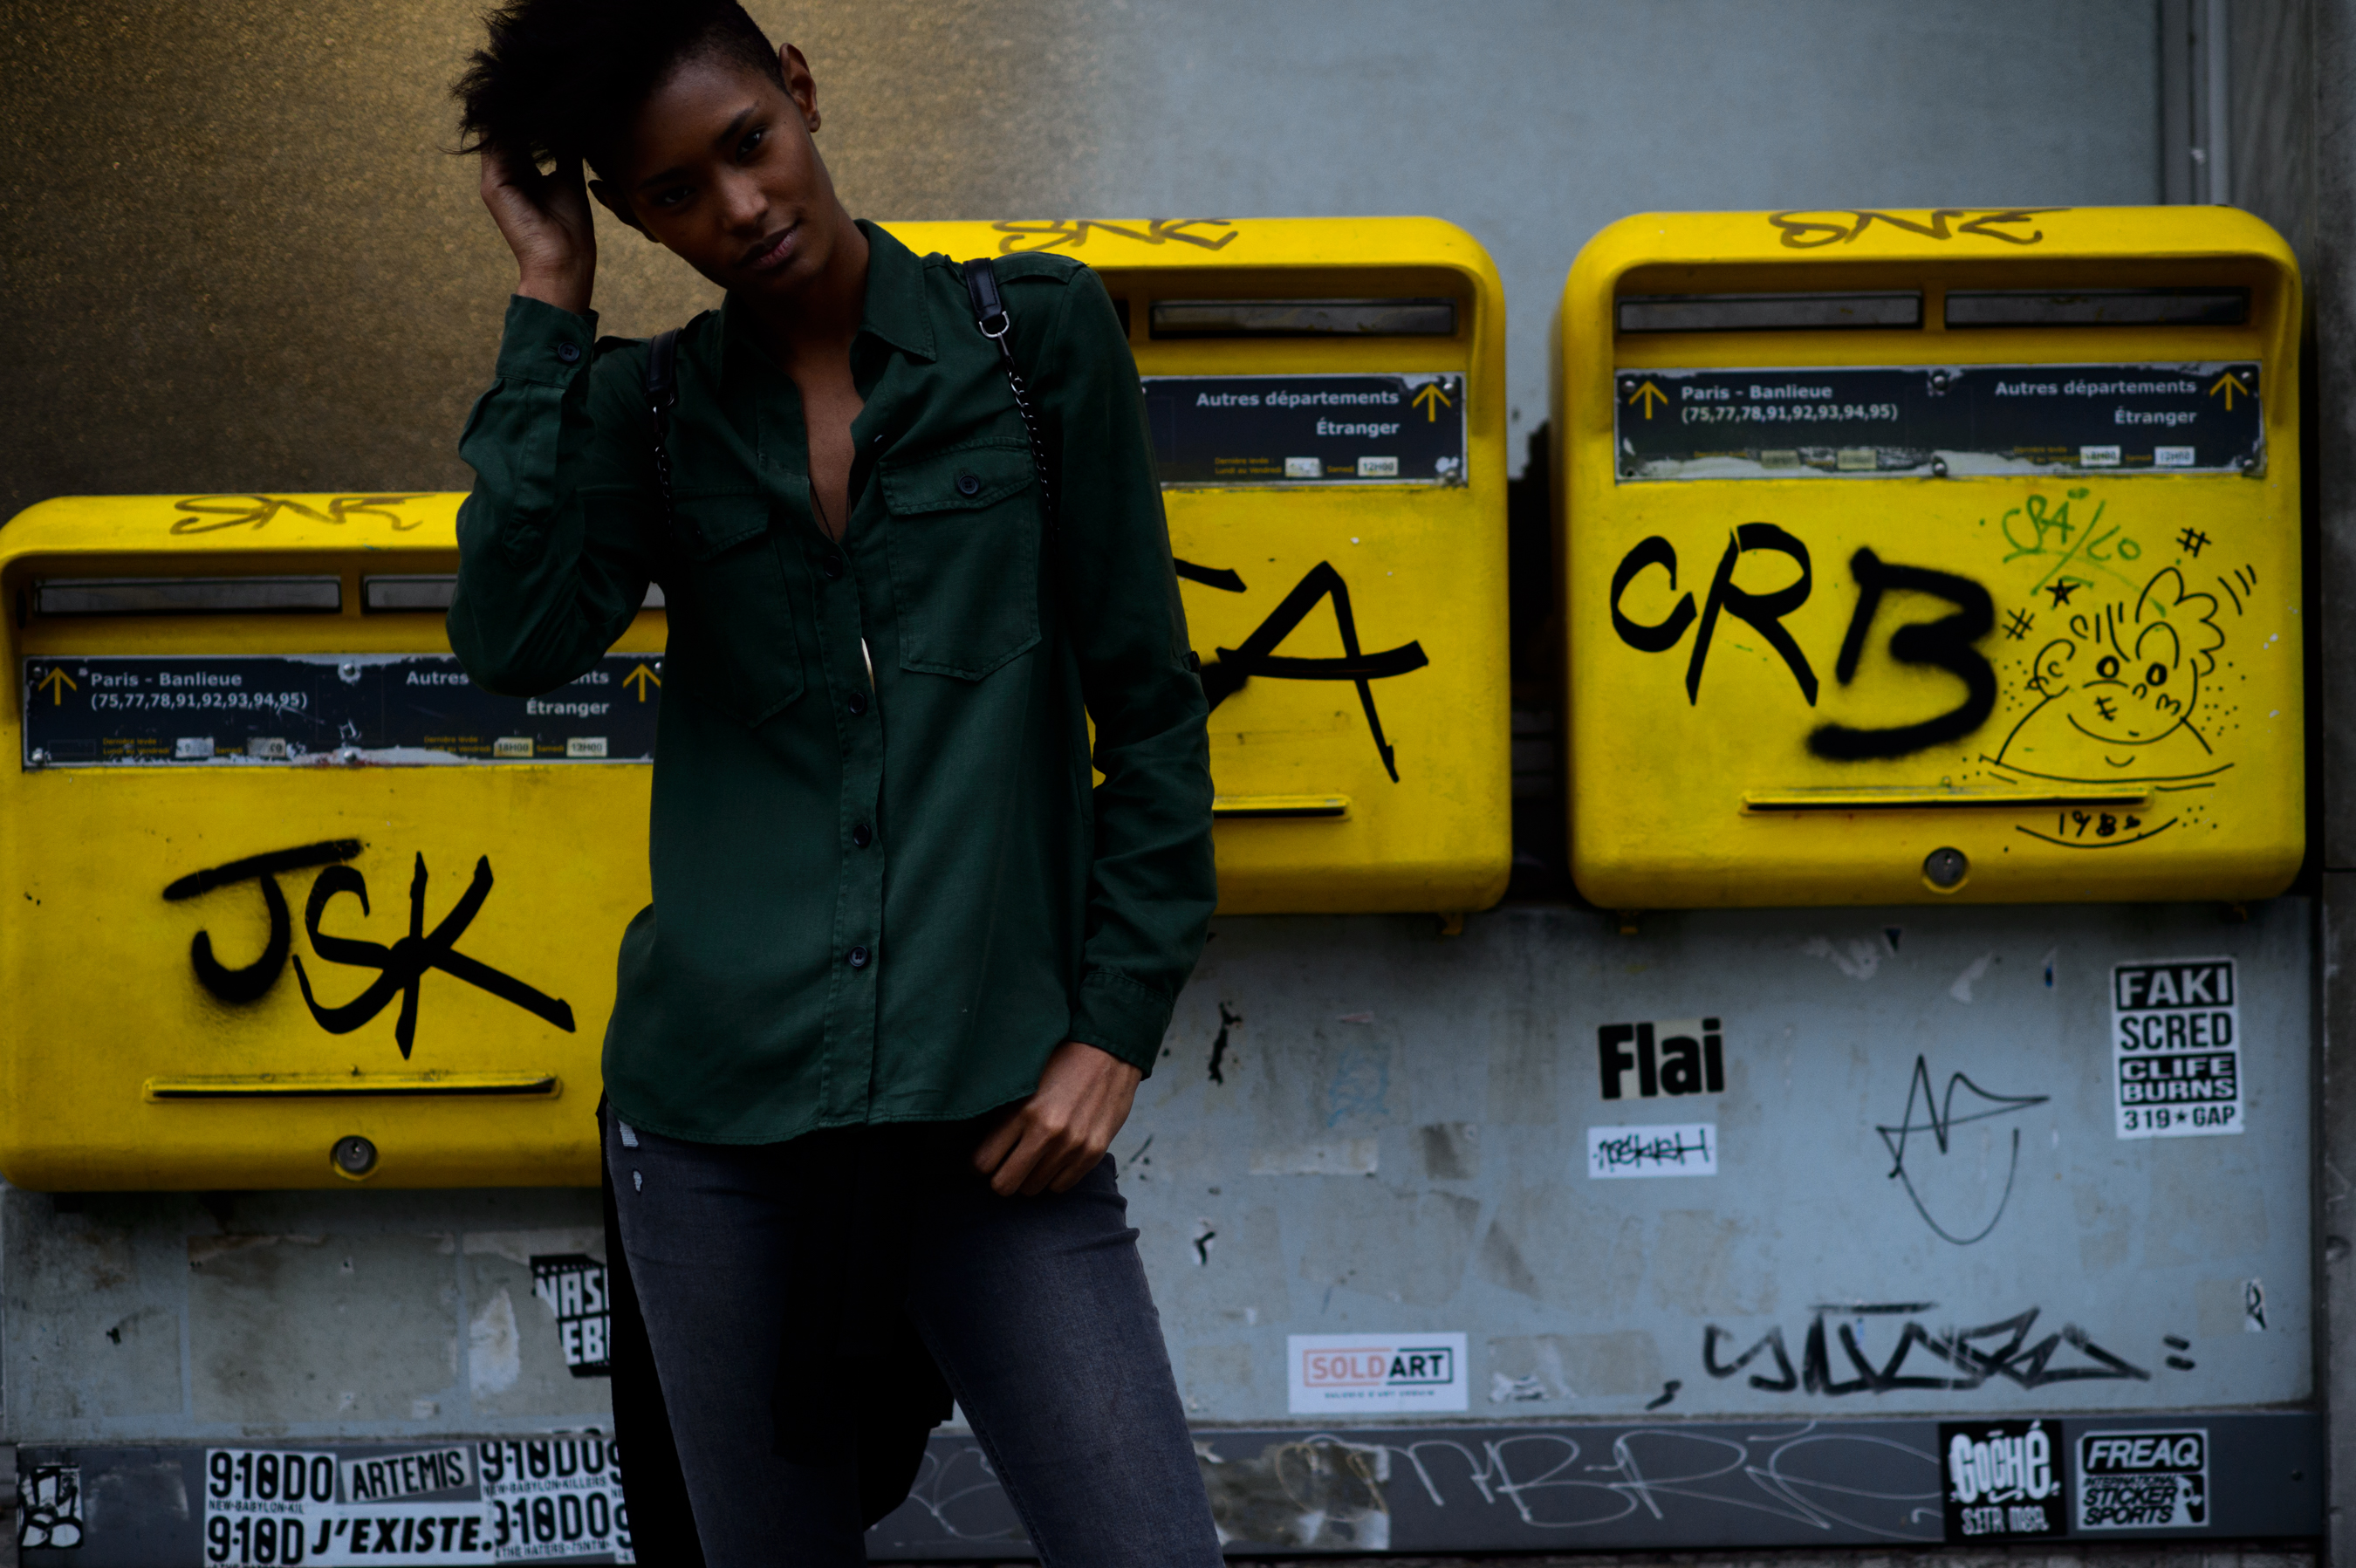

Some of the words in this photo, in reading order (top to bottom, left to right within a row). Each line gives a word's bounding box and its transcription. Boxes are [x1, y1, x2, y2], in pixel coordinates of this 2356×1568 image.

[1195, 392, 1259, 407] Autres
[1264, 390, 1400, 407] départements
[1681, 386, 1730, 401] Paris
[1750, 385, 1832, 400] Banlieue
[1995, 380, 2058, 396] Autres
[2063, 379, 2197, 397] départements
[2114, 406, 2197, 427] Étranger
[1316, 417, 1400, 438] Étranger
[91, 672, 139, 688] Paris
[159, 672, 243, 688] Banlieue
[406, 669, 469, 686] Autres
[526, 698, 610, 718] Étranger
[162, 838, 576, 1061] JSK
[2120, 967, 2230, 1007] FAKI
[2120, 1013, 2232, 1051] SCRED
[1599, 1017, 1723, 1099] Flai
[2122, 1056, 2234, 1080] CLIFE
[2122, 1078, 2235, 1102] BURNS
[2124, 1109, 2171, 1130] 319
[2193, 1106, 2236, 1126] GAP
[2086, 1436, 2200, 1469] FREAQ
[353, 1450, 464, 1500] ARTEMIS
[2084, 1486, 2178, 1505] STICKER
[2084, 1505, 2174, 1525] SPORTS
